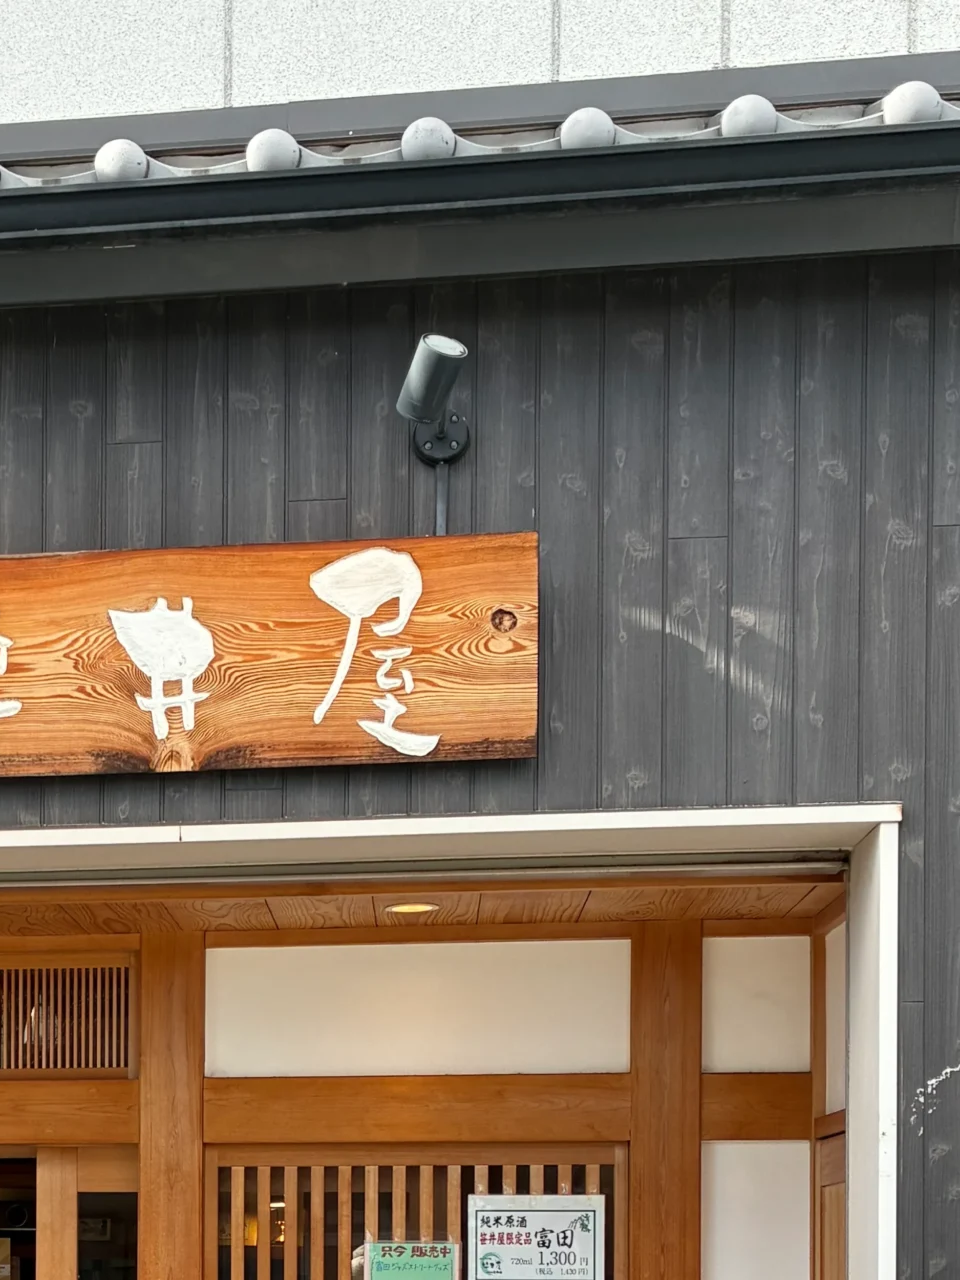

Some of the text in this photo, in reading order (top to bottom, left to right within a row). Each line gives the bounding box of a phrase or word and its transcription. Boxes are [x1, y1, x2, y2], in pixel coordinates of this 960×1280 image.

[480, 1215, 528, 1229] 純米原酒
[479, 1227, 575, 1249] 笹井屋限定品 富田
[381, 1245, 452, 1258] 只今 販売中
[510, 1251, 589, 1267] 720ml 1,300 円
